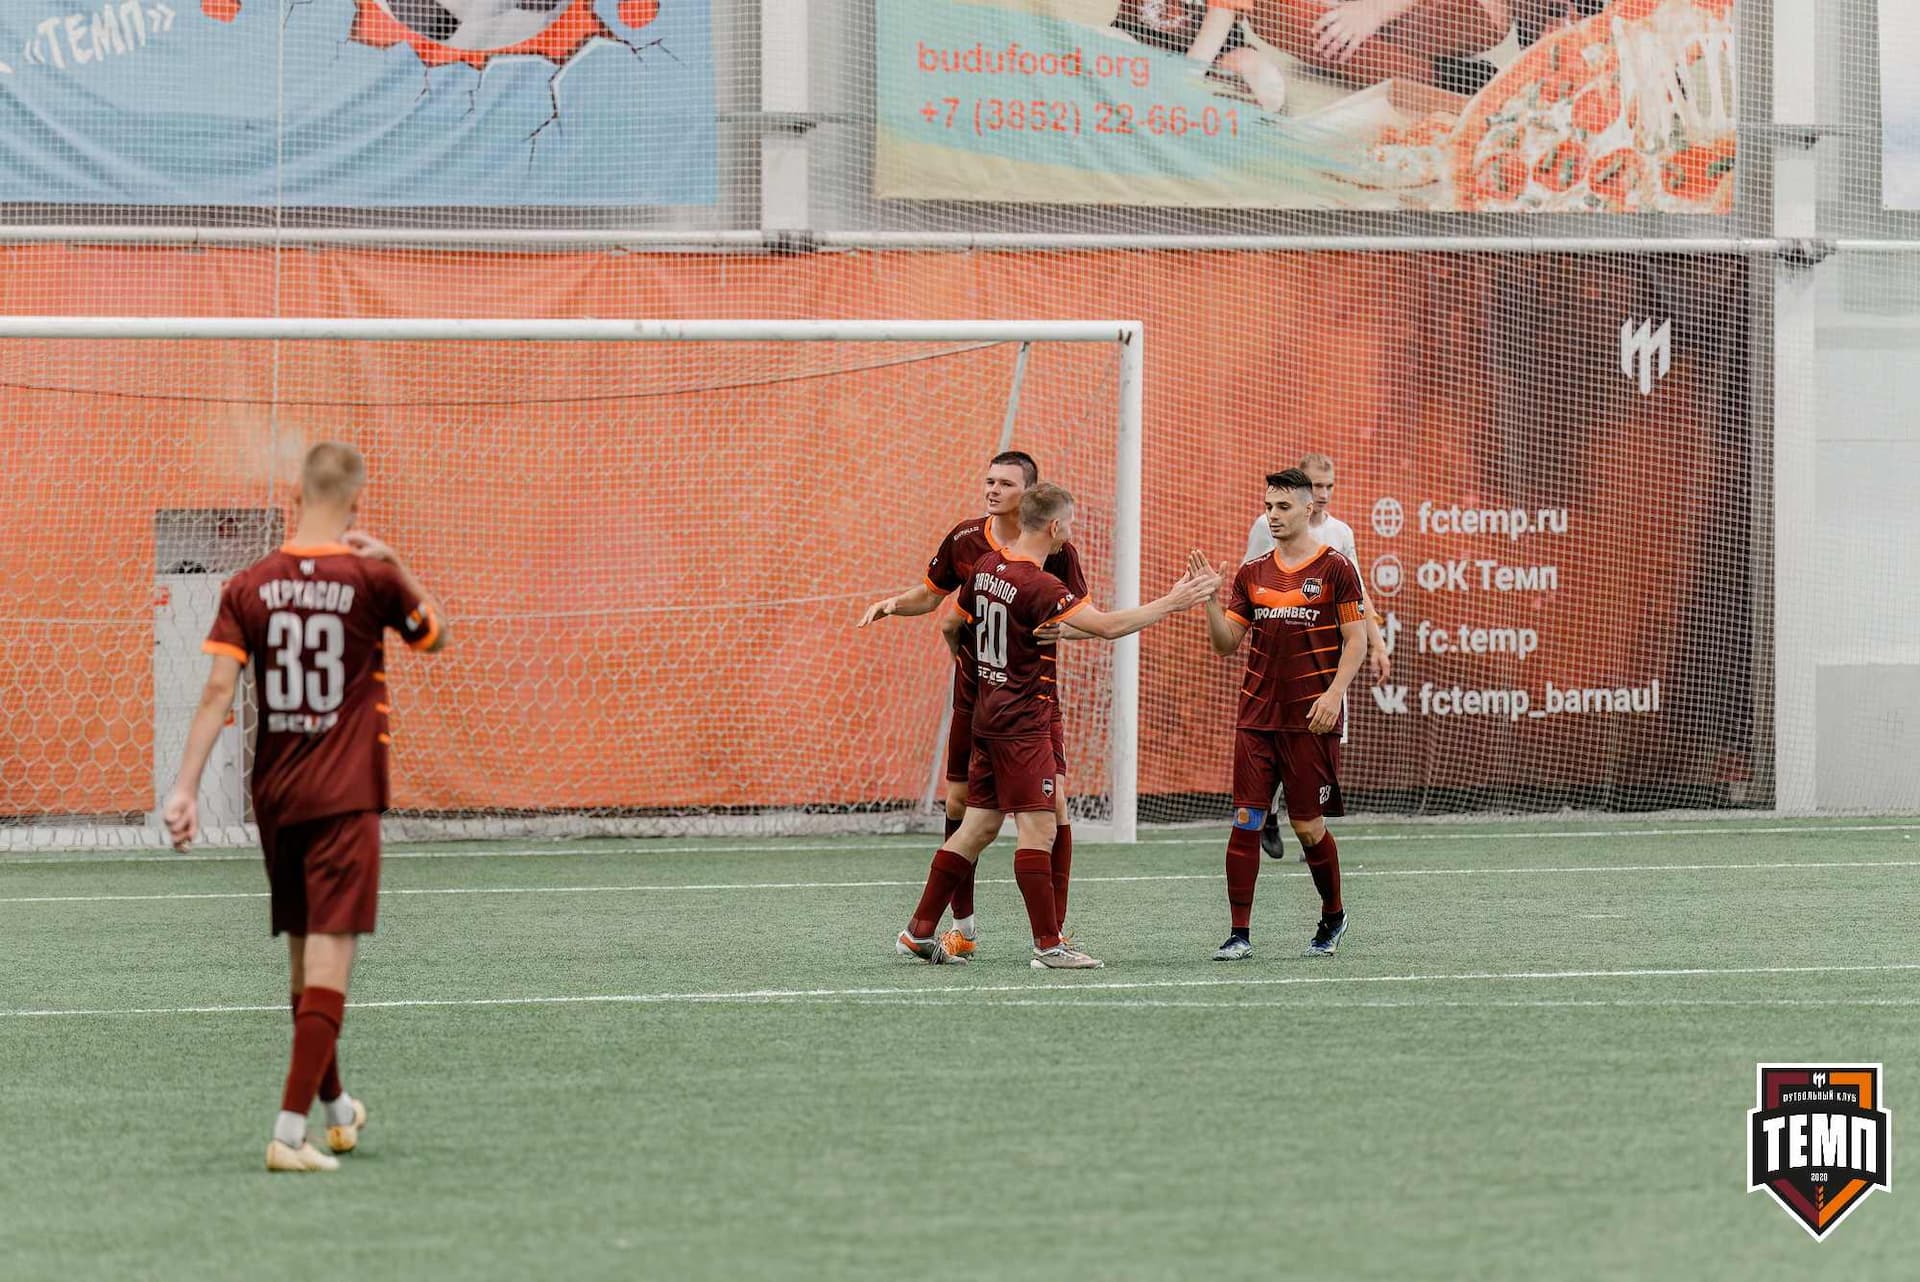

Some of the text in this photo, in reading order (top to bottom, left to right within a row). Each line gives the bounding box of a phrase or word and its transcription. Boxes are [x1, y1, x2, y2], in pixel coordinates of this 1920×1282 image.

[917, 41, 1150, 87] budufood.org
[919, 97, 1239, 137] +7 (3852) 22-66-01
[1418, 501, 1568, 540] fctemp.ru
[1416, 560, 1559, 593] ФК Темп
[975, 594, 1008, 669] 20
[1416, 621, 1538, 660] fc.temp
[265, 611, 345, 713] 33
[1418, 679, 1660, 721] fctemp_barnaul
